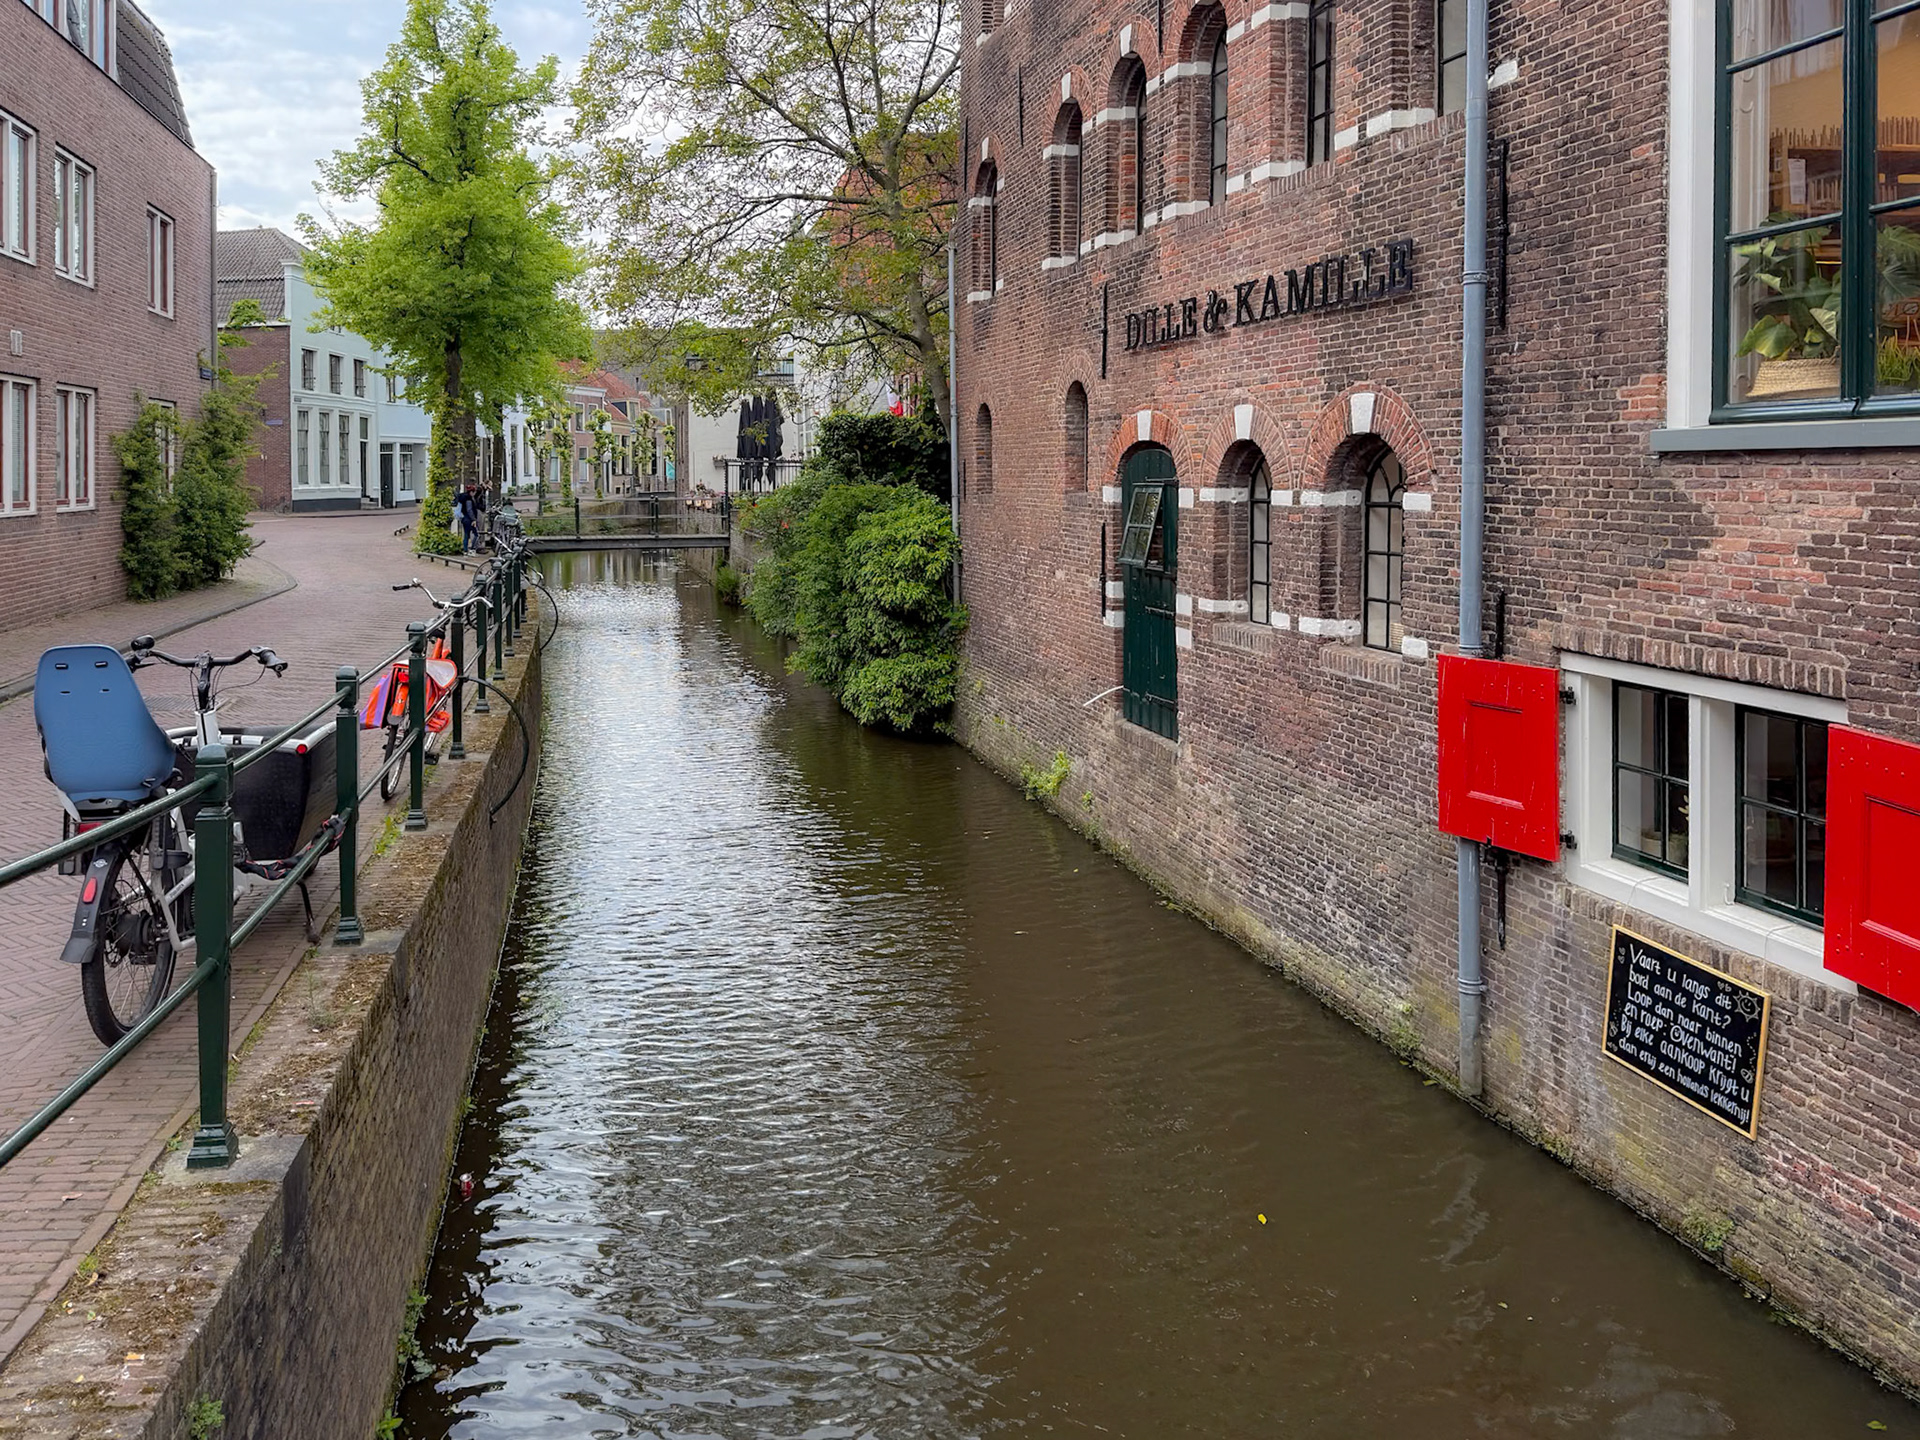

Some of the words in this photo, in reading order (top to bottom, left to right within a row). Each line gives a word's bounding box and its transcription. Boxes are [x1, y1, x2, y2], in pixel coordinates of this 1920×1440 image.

[1125, 297, 1197, 350] DILLE
[1203, 289, 1227, 333] &
[1232, 238, 1413, 328] KAMILLE
[1629, 964, 1649, 990] bord
[1653, 984, 1672, 1001] aan
[1674, 992, 1687, 1008] de
[1630, 943, 1661, 975] Vaart
[1667, 968, 1677, 983] u
[1682, 974, 1711, 1000] langs
[1715, 993, 1732, 1010] dit
[1624, 1002, 1637, 1020] en
[1627, 982, 1652, 1008] Loop
[1655, 1002, 1674, 1021] dan
[1678, 1013, 1702, 1034] naar
[1706, 1027, 1742, 1057] binnen
[1619, 1037, 1637, 1057] dan
[1658, 1062, 1675, 1080] een
[1621, 1013, 1632, 1038] Bij
[1634, 1026, 1654, 1046] elke
[1660, 1041, 1706, 1075] aankoop
[1741, 1087, 1750, 1103] u
